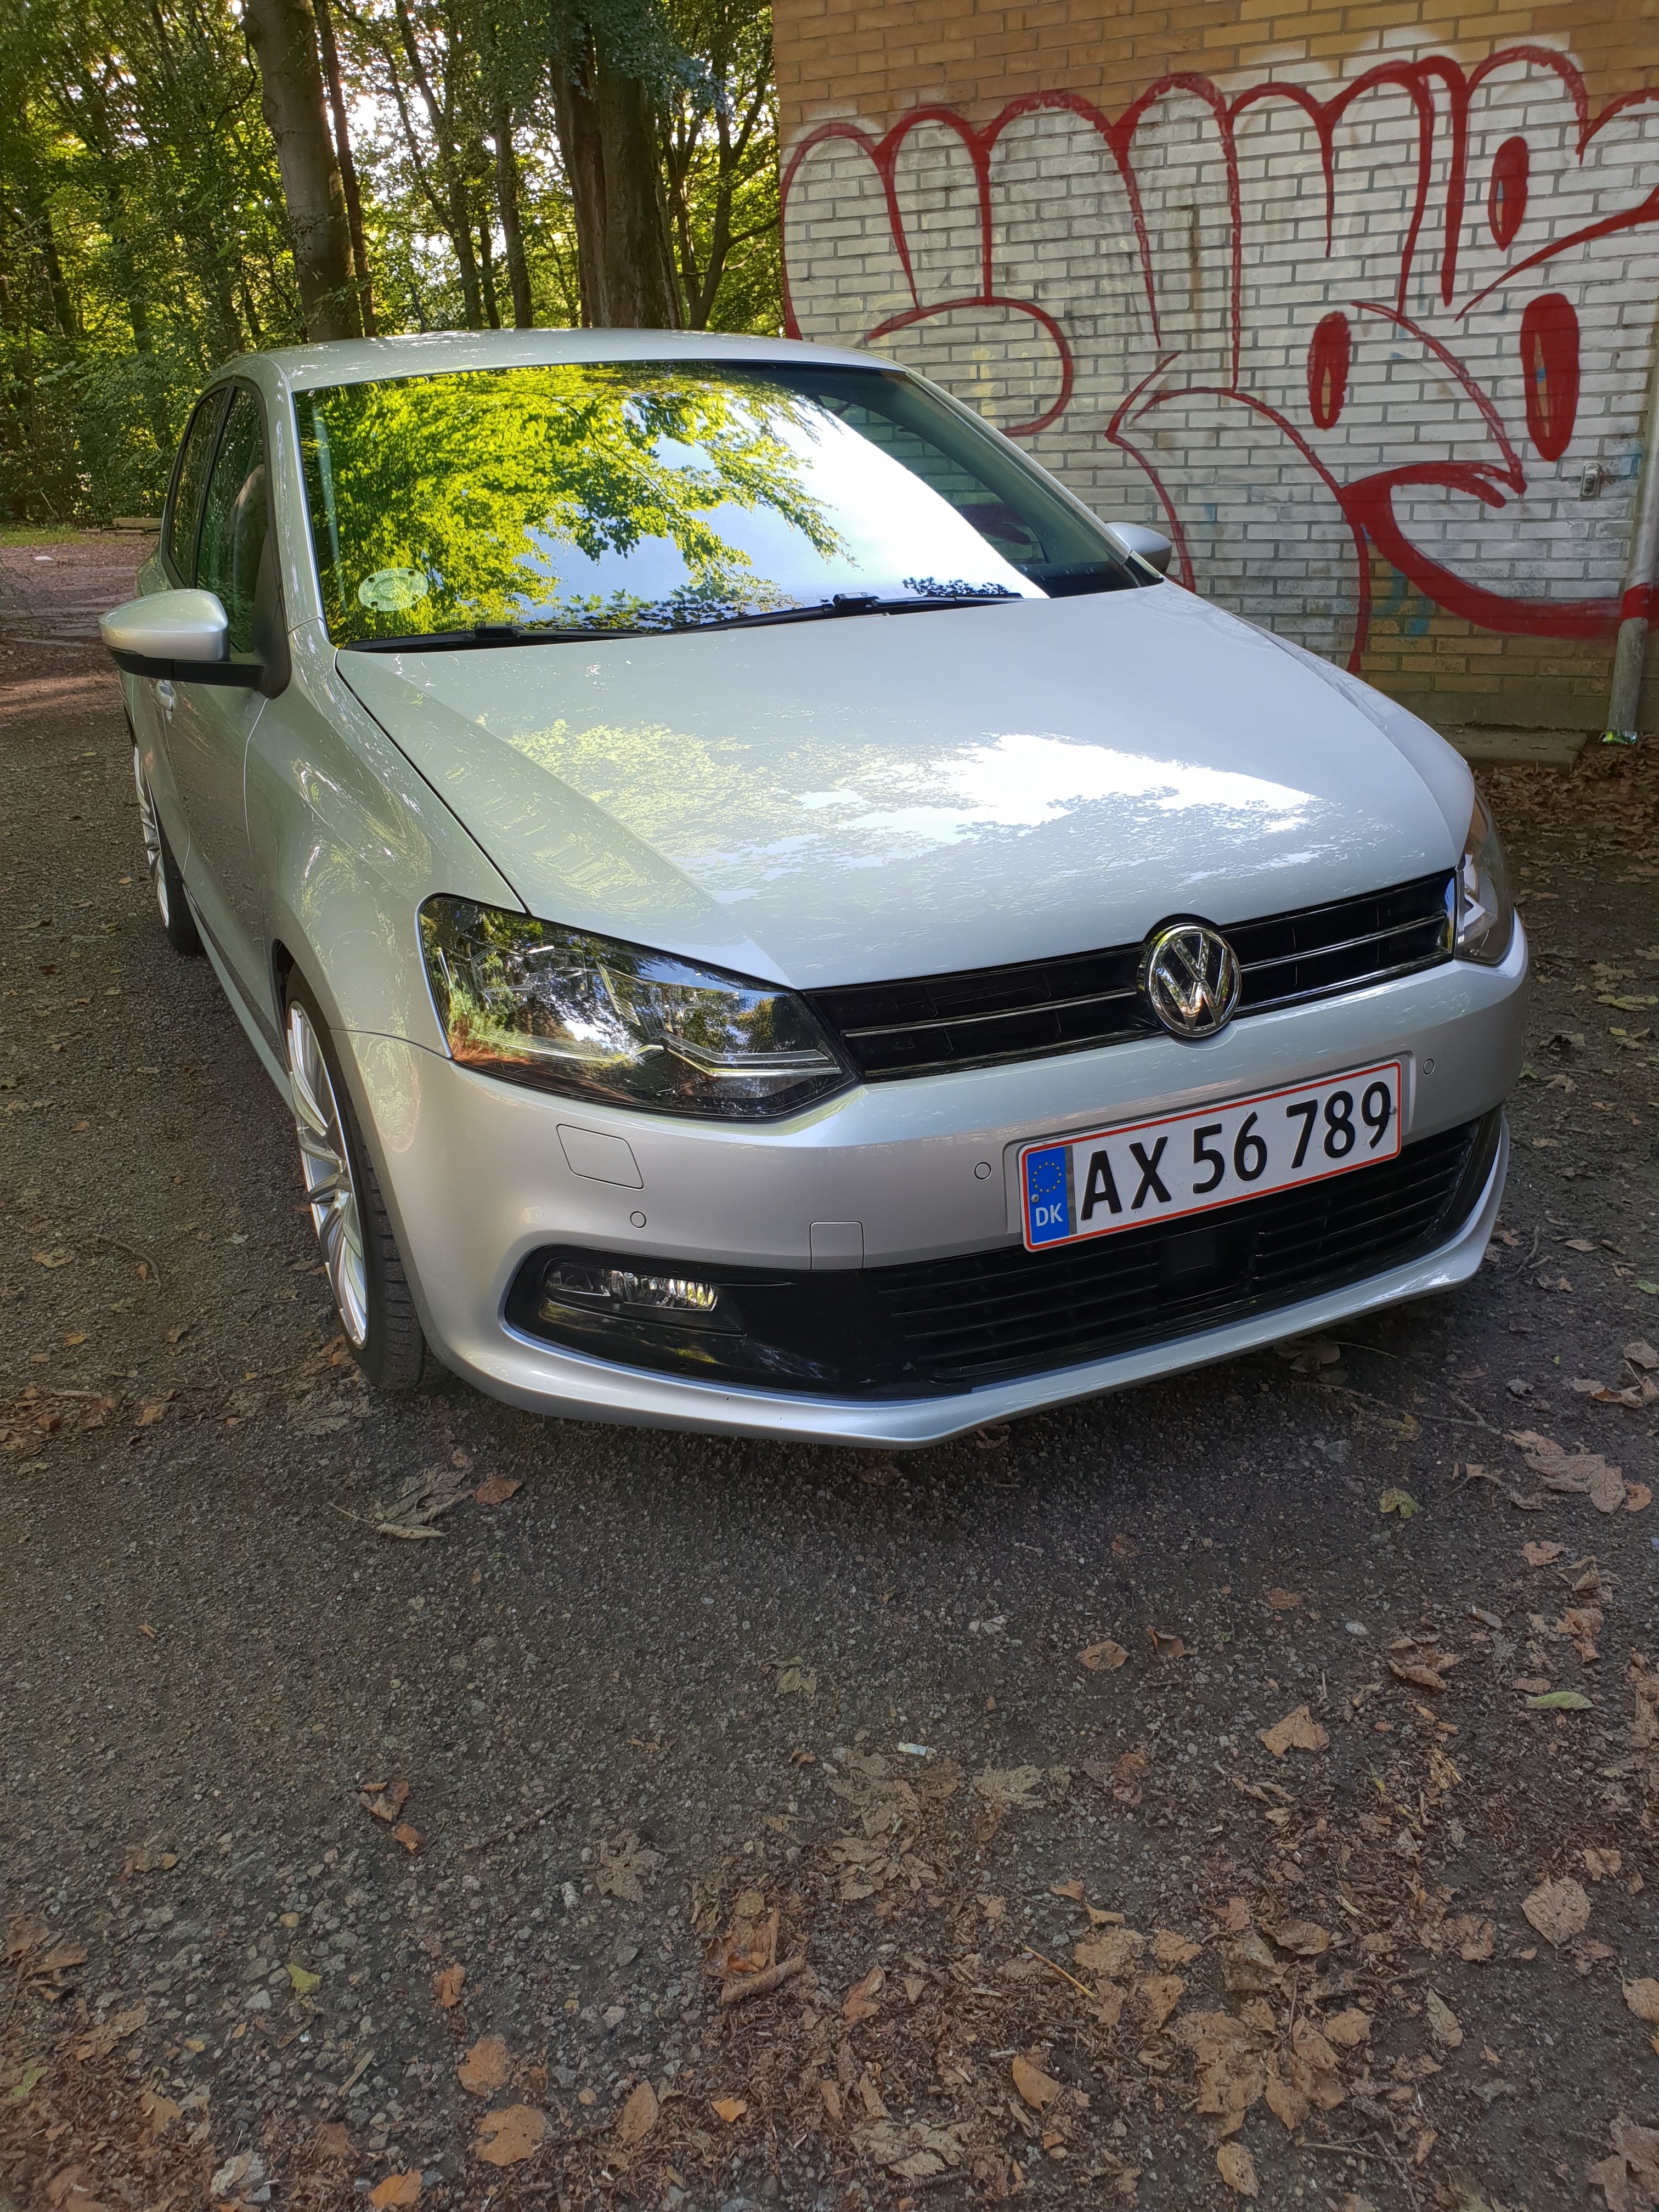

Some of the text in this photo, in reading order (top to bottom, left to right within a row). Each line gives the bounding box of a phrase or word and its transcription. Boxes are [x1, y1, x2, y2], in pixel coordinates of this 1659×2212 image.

[1080, 1081, 1392, 1221] AX 56 789
[1035, 1203, 1063, 1227] DK
